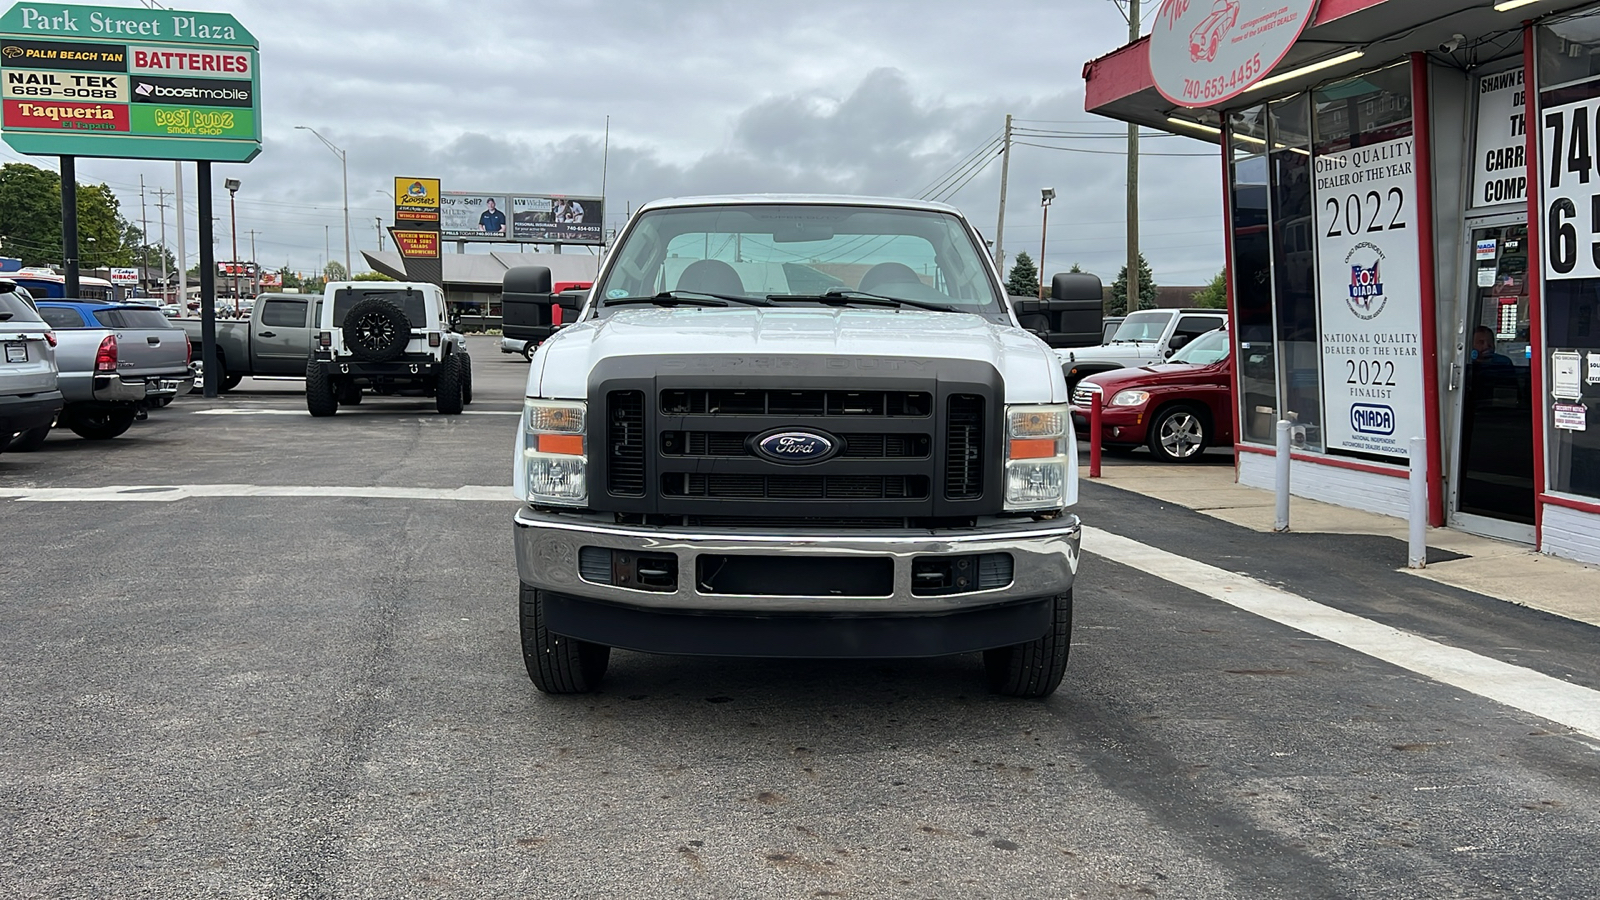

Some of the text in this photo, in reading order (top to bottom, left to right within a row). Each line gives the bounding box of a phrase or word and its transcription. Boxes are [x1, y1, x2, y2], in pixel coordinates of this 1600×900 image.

[21, 8, 236, 40] Park Street Plaza
[1231, 35, 1243, 43] Home
[1257, 20, 1276, 34] SAWEET
[26, 49, 123, 61] PALM BEACH TAN
[135, 51, 248, 73] BATTERIES
[8, 73, 117, 88] NAIL TEK
[1183, 53, 1261, 99] 740-653-4455
[1481, 71, 1515, 93] SHAWN
[12, 86, 117, 98] 689-9088
[18, 103, 114, 121] Taqueria
[62, 121, 116, 130] El Tapatio
[1545, 103, 1600, 189] 74
[1316, 140, 1413, 173] OHIO QUALITY
[1317, 161, 1412, 190] DEALER OF THE YEAR
[1484, 176, 1528, 202] COMP
[401, 195, 435, 204] Roosters
[441, 198, 456, 206] Buy
[1325, 186, 1406, 238] 2022
[1353, 285, 1378, 296] OIADA
[1324, 334, 1418, 344] NATIONAL QUALITY
[1325, 346, 1356, 354] DEALER
[1373, 347, 1390, 355] THE
[1394, 348, 1417, 356] YEAR
[1346, 360, 1396, 386] 2022
[1350, 388, 1392, 398] FINALIST
[1354, 410, 1391, 429] NIADA
[776, 437, 815, 453] Ford
